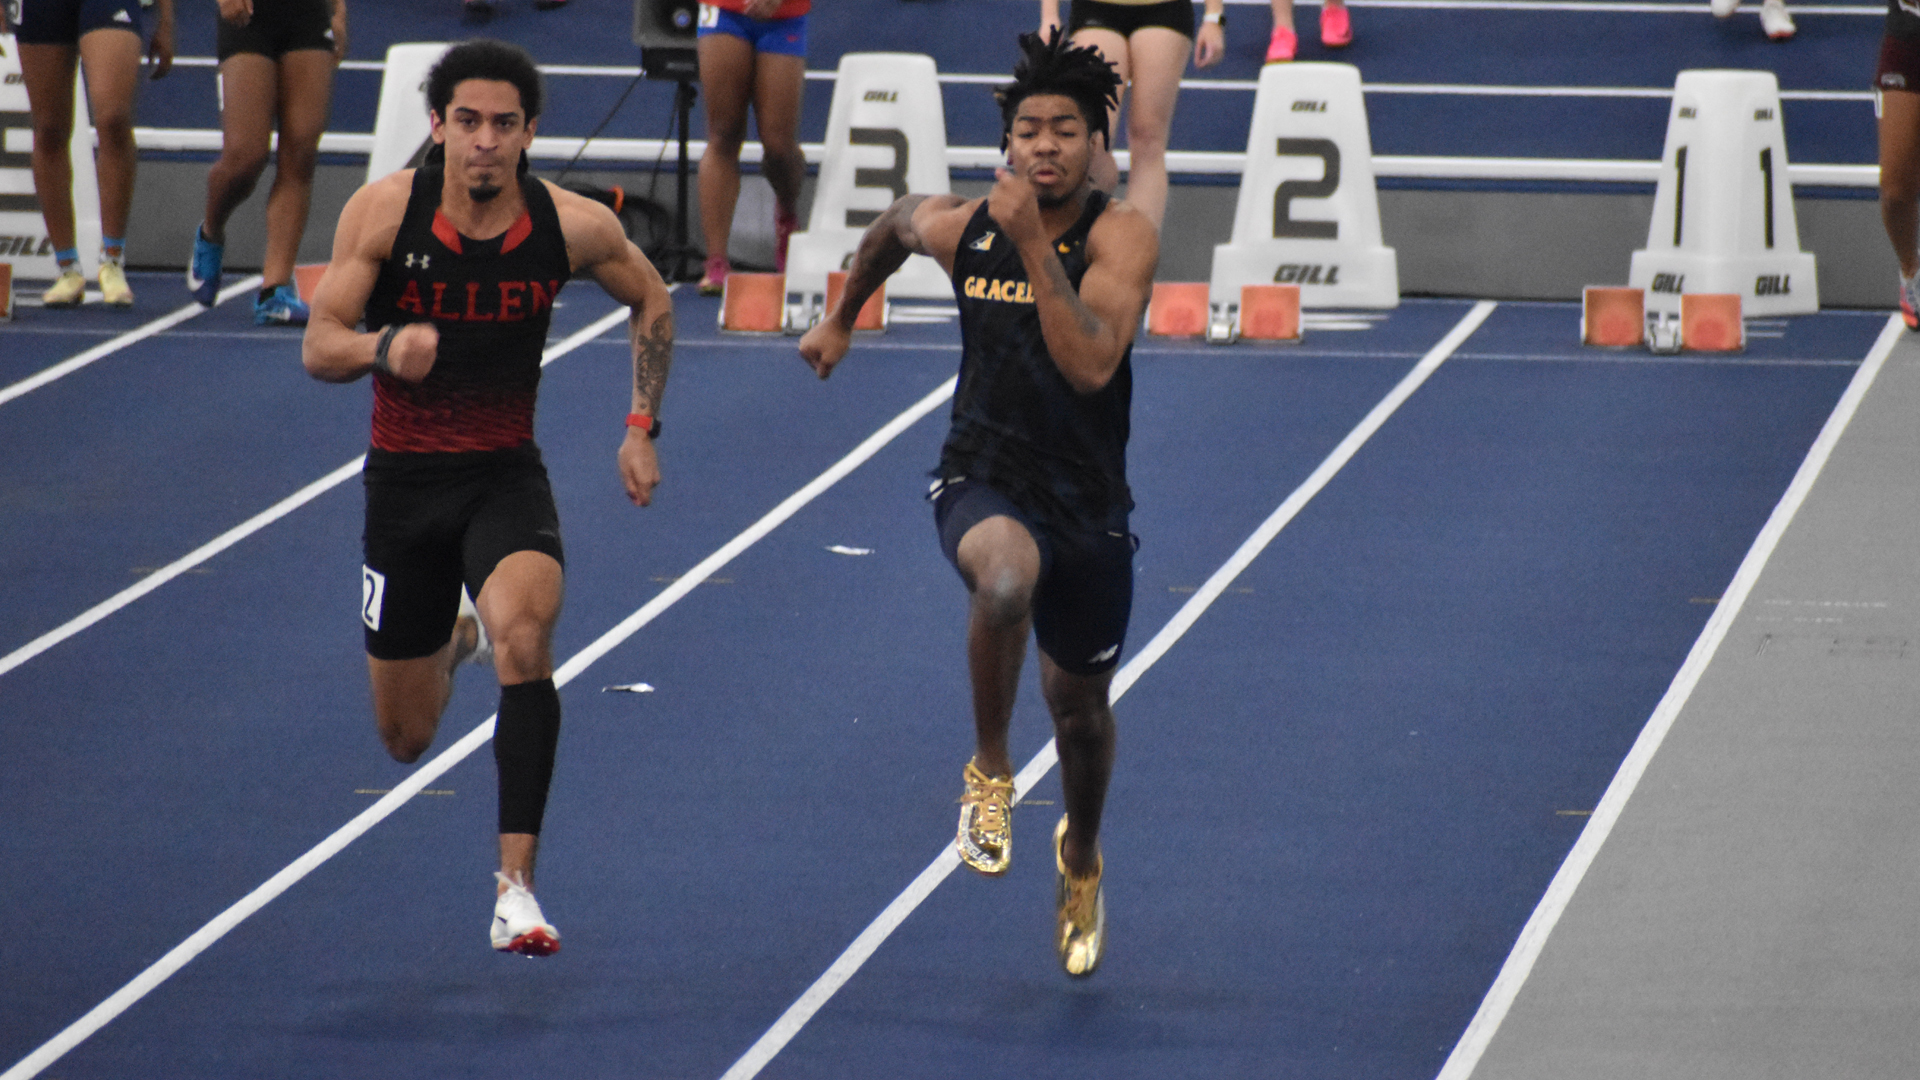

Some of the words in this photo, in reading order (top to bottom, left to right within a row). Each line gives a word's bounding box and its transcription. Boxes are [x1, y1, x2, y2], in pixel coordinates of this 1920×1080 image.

[863, 89, 899, 103] GILL
[1290, 100, 1328, 113] GILL
[845, 127, 909, 228] 3
[1272, 138, 1340, 240] 2
[1673, 145, 1687, 247] 1
[1760, 147, 1774, 248] 1
[1273, 263, 1340, 285] GILL
[1651, 272, 1684, 295] GILL
[1754, 273, 1791, 296] GILL
[396, 279, 559, 322] ALLEN
[364, 573, 376, 624] 2
